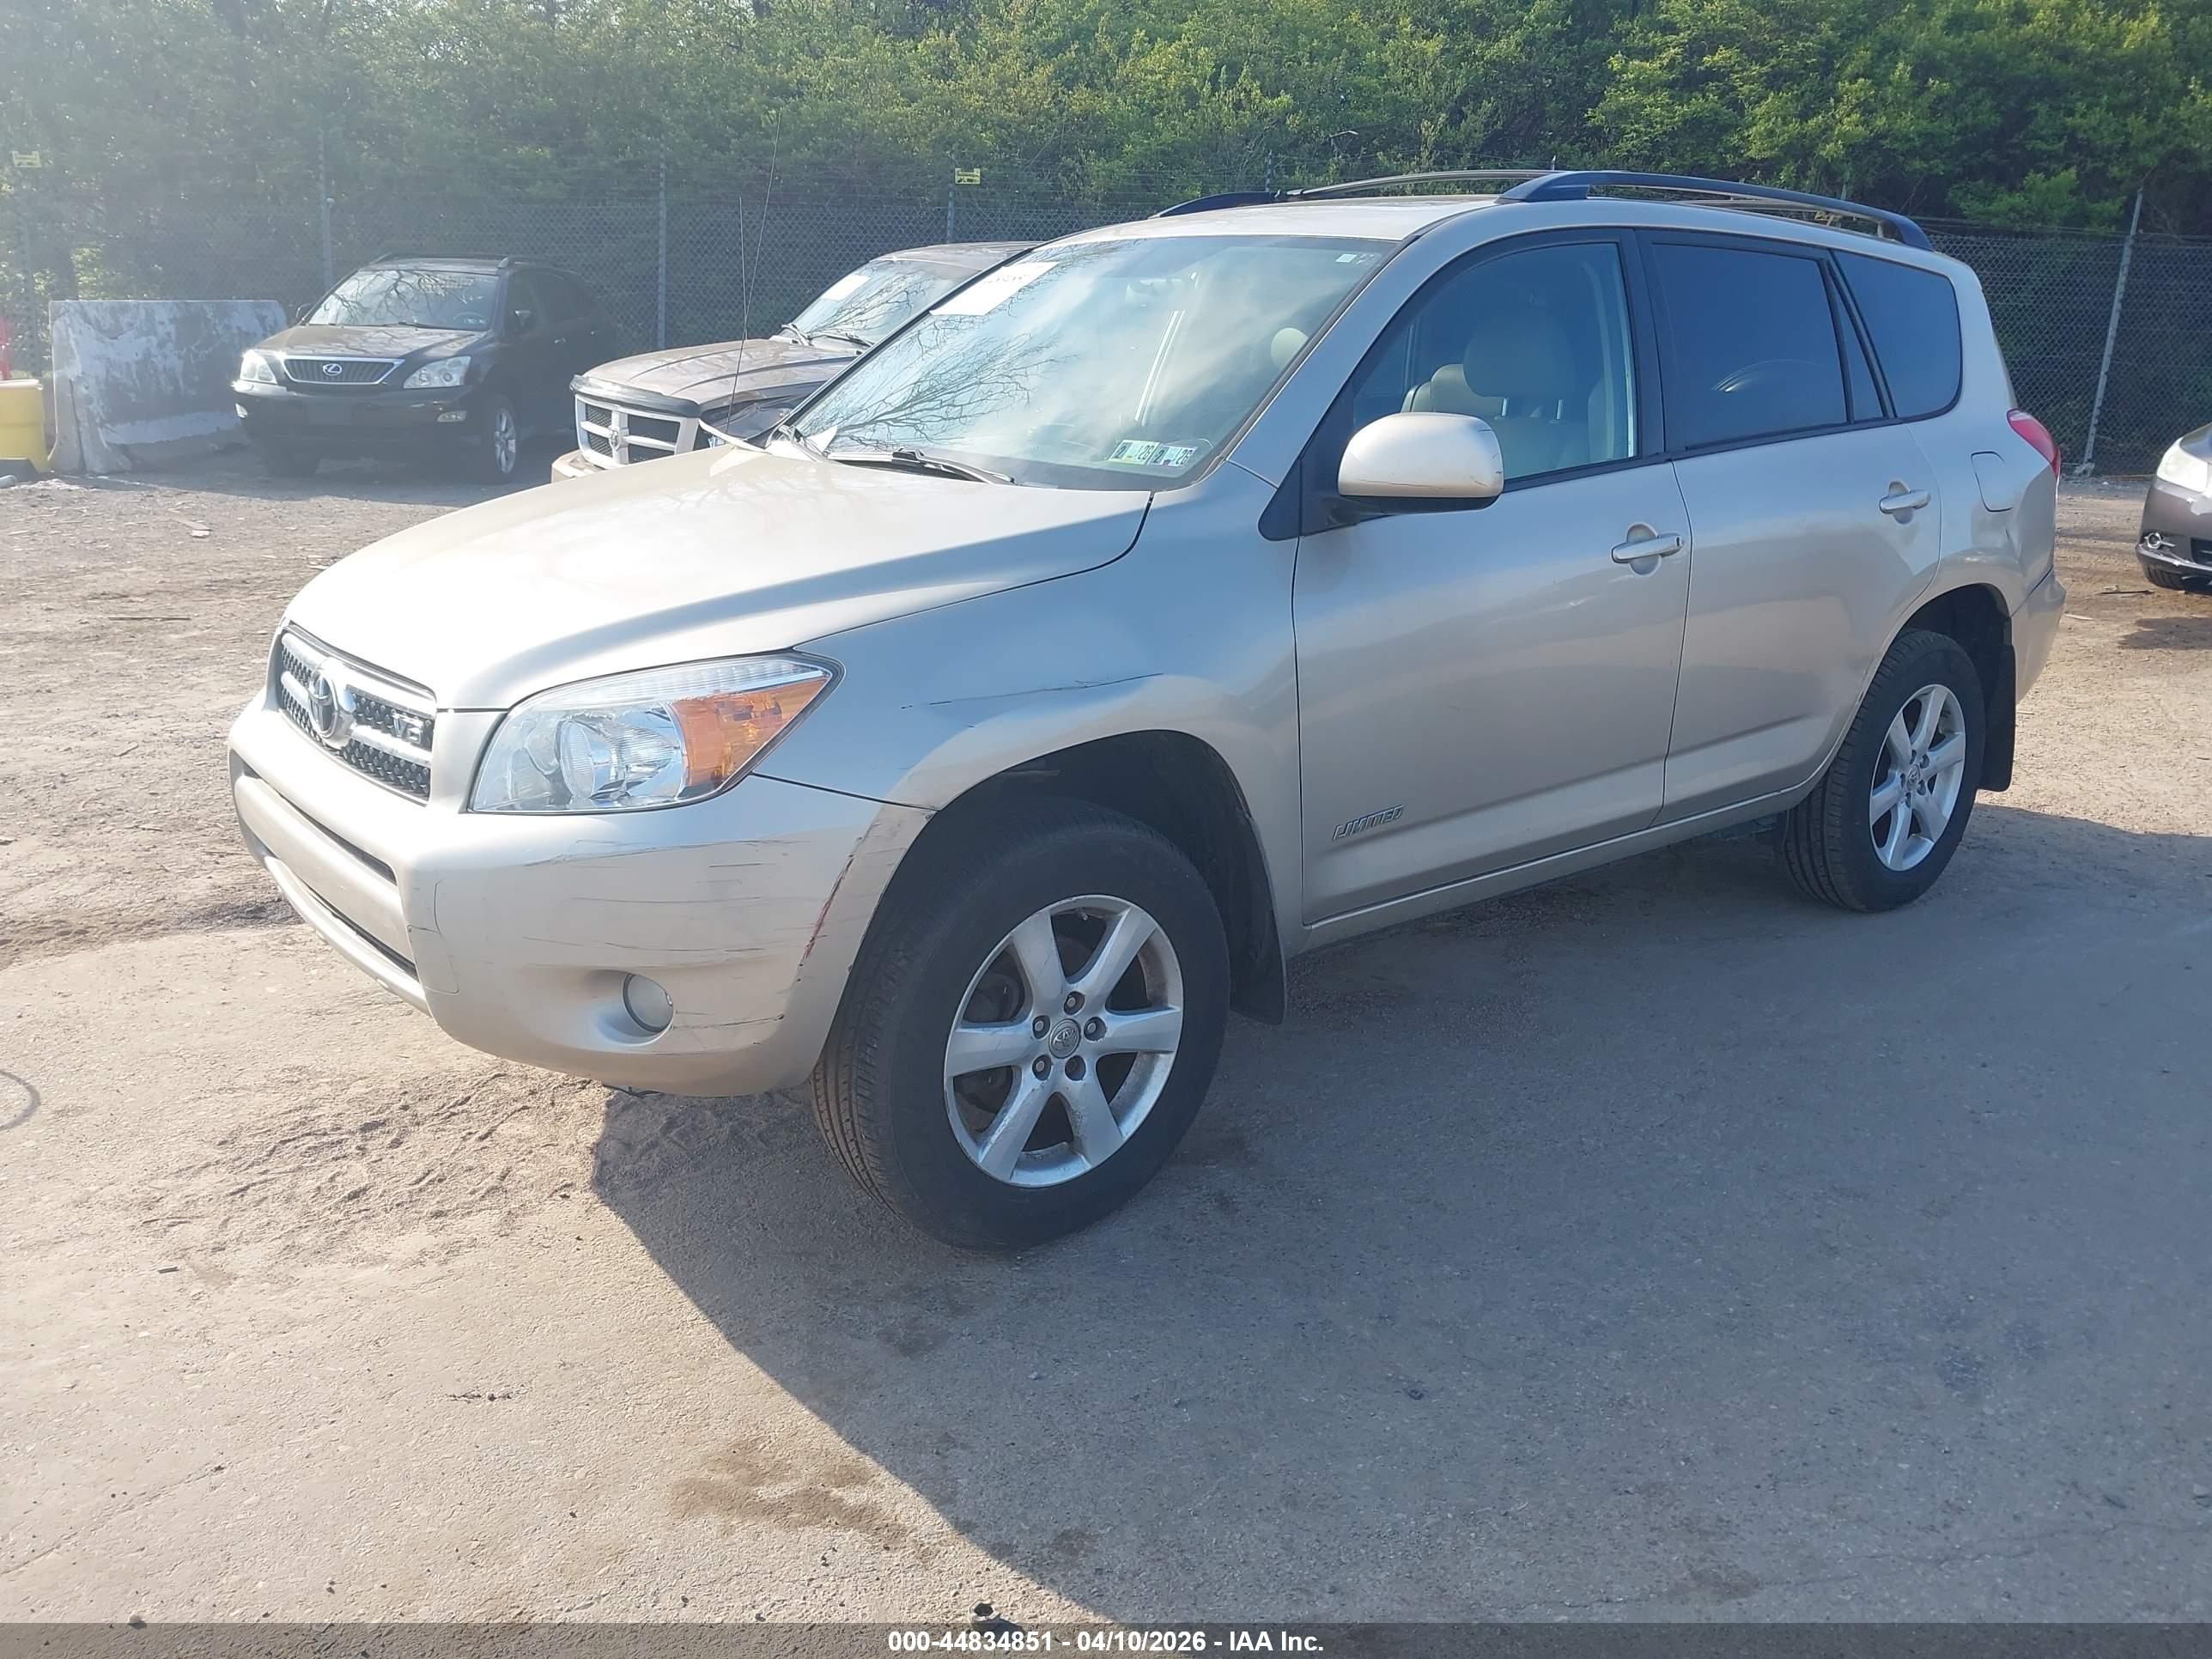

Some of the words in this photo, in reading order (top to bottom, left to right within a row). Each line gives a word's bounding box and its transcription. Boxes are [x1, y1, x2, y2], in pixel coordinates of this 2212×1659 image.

[1112, 445, 1127, 459] 2
[1153, 449, 1165, 464] 2
[1176, 449, 1194, 465] 26
[392, 714, 423, 744] V6
[1333, 805, 1404, 841] LIMITED
